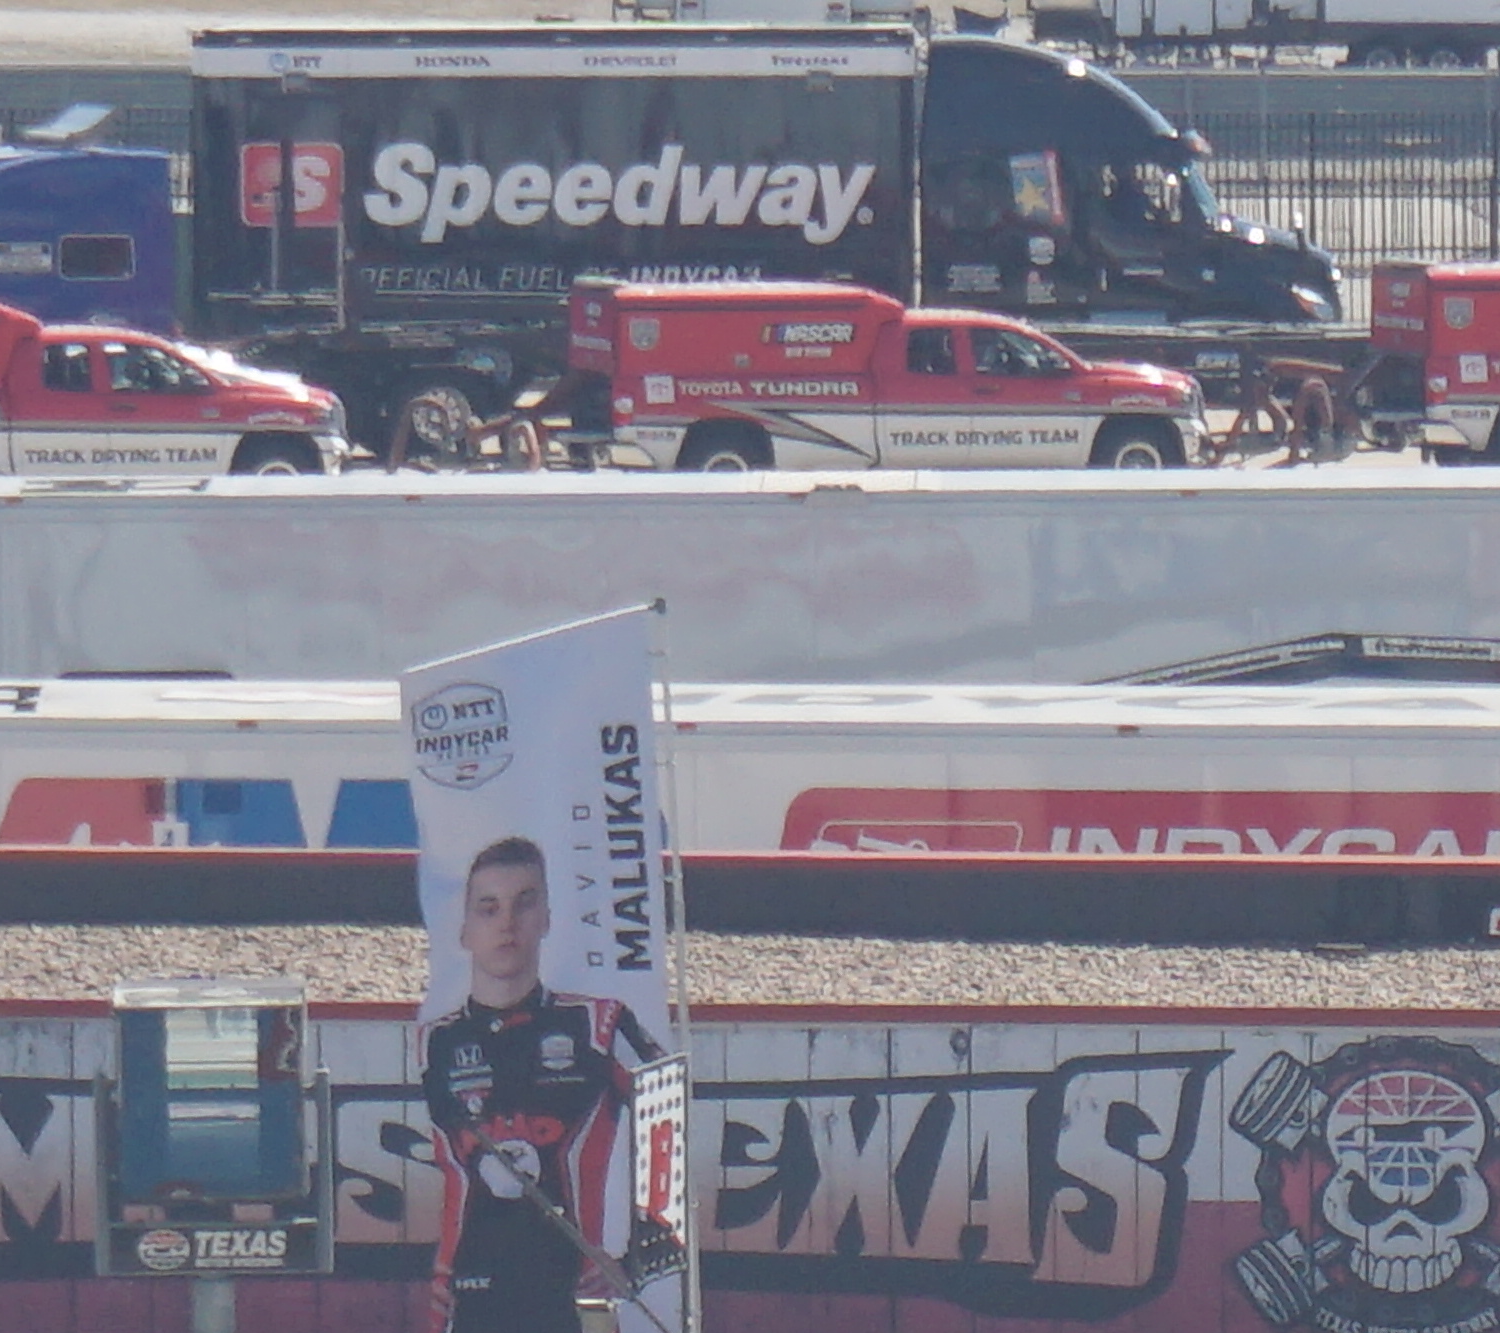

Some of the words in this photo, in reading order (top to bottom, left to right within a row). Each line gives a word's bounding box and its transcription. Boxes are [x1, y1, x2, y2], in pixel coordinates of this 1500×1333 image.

[414, 56, 490, 67] HONDA
[364, 141, 873, 244] Speedway
[500, 266, 569, 289] FUEL
[678, 380, 743, 396] TOYOTA
[750, 381, 859, 396] TUNDRA
[890, 432, 949, 446] TRACK
[955, 431, 1023, 446] DRYING
[1028, 430, 1079, 445] TEAM
[24, 449, 87, 464] TRACK
[91, 449, 161, 464] DRYING
[164, 448, 218, 463] TEAM
[451, 698, 495, 721] NTT
[416, 725, 510, 754] INDYCAR
[601, 723, 652, 971] MALUKAS
[572, 804, 604, 967] DAVID
[688, 1065, 1202, 1288] EXAS
[194, 1230, 288, 1257] TEXAS
